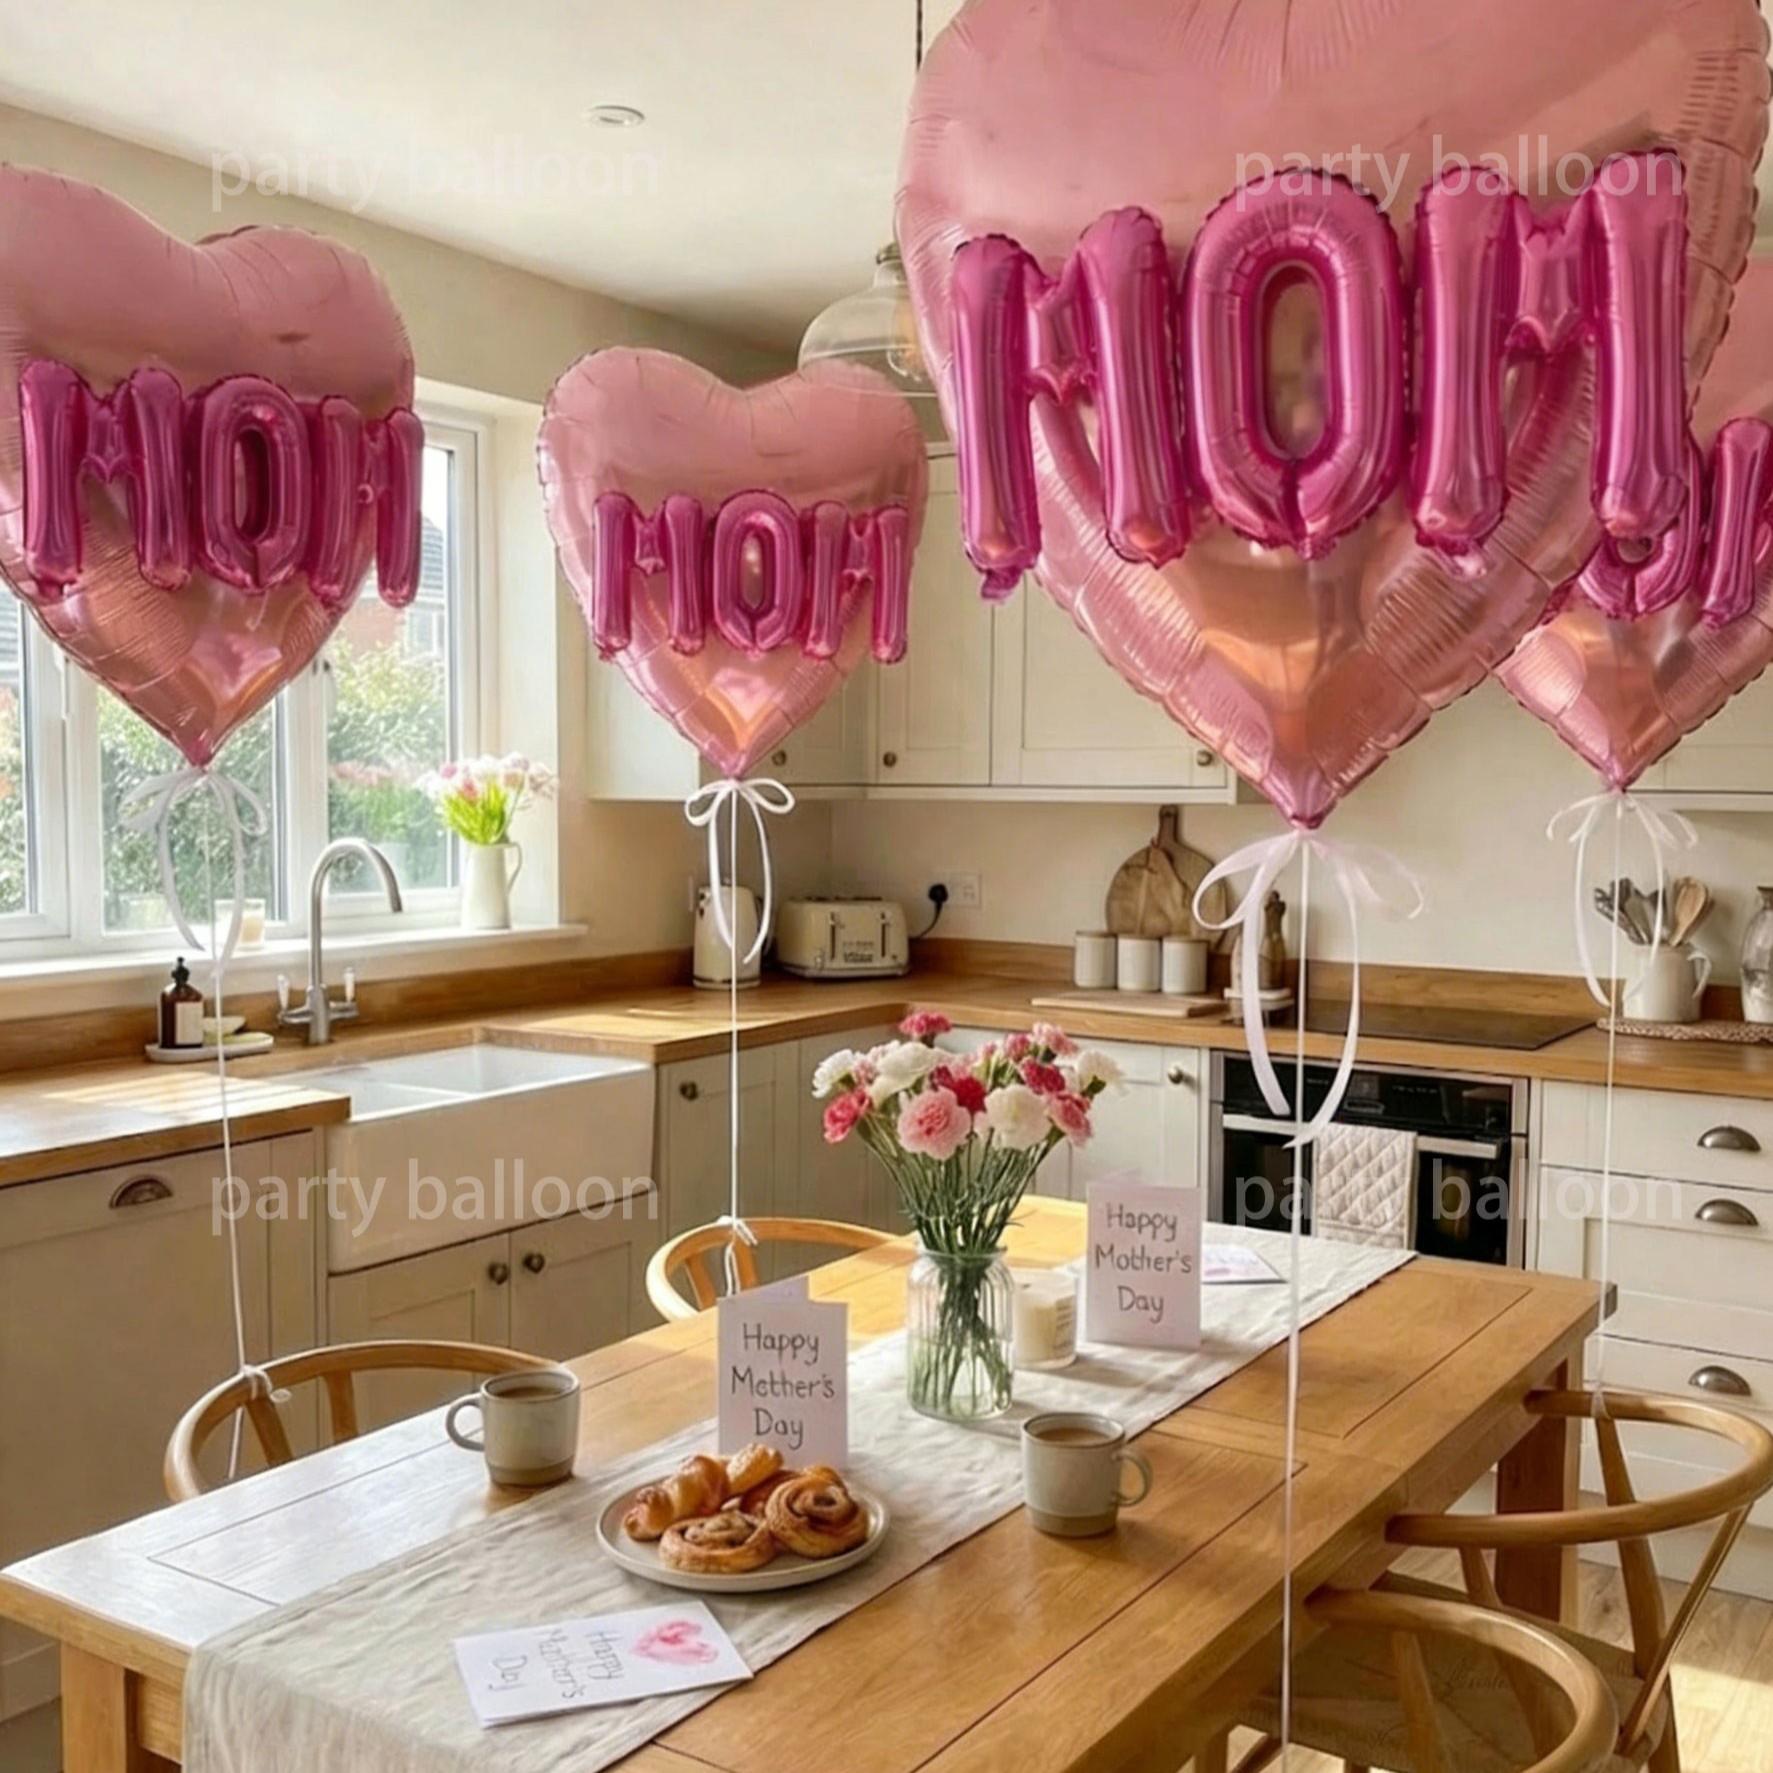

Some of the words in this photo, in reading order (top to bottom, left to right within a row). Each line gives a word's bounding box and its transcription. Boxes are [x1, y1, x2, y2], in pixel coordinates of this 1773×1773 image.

[953, 147, 1689, 600] MOM
[20, 359, 425, 607] MOM
[592, 489, 908, 664] MOM
[1107, 1203, 1178, 1242] Happy
[1095, 1244, 1193, 1274] Mother's
[1117, 1285, 1164, 1324] Day
[742, 1322, 820, 1366] Happy
[754, 1407, 804, 1450] Day
